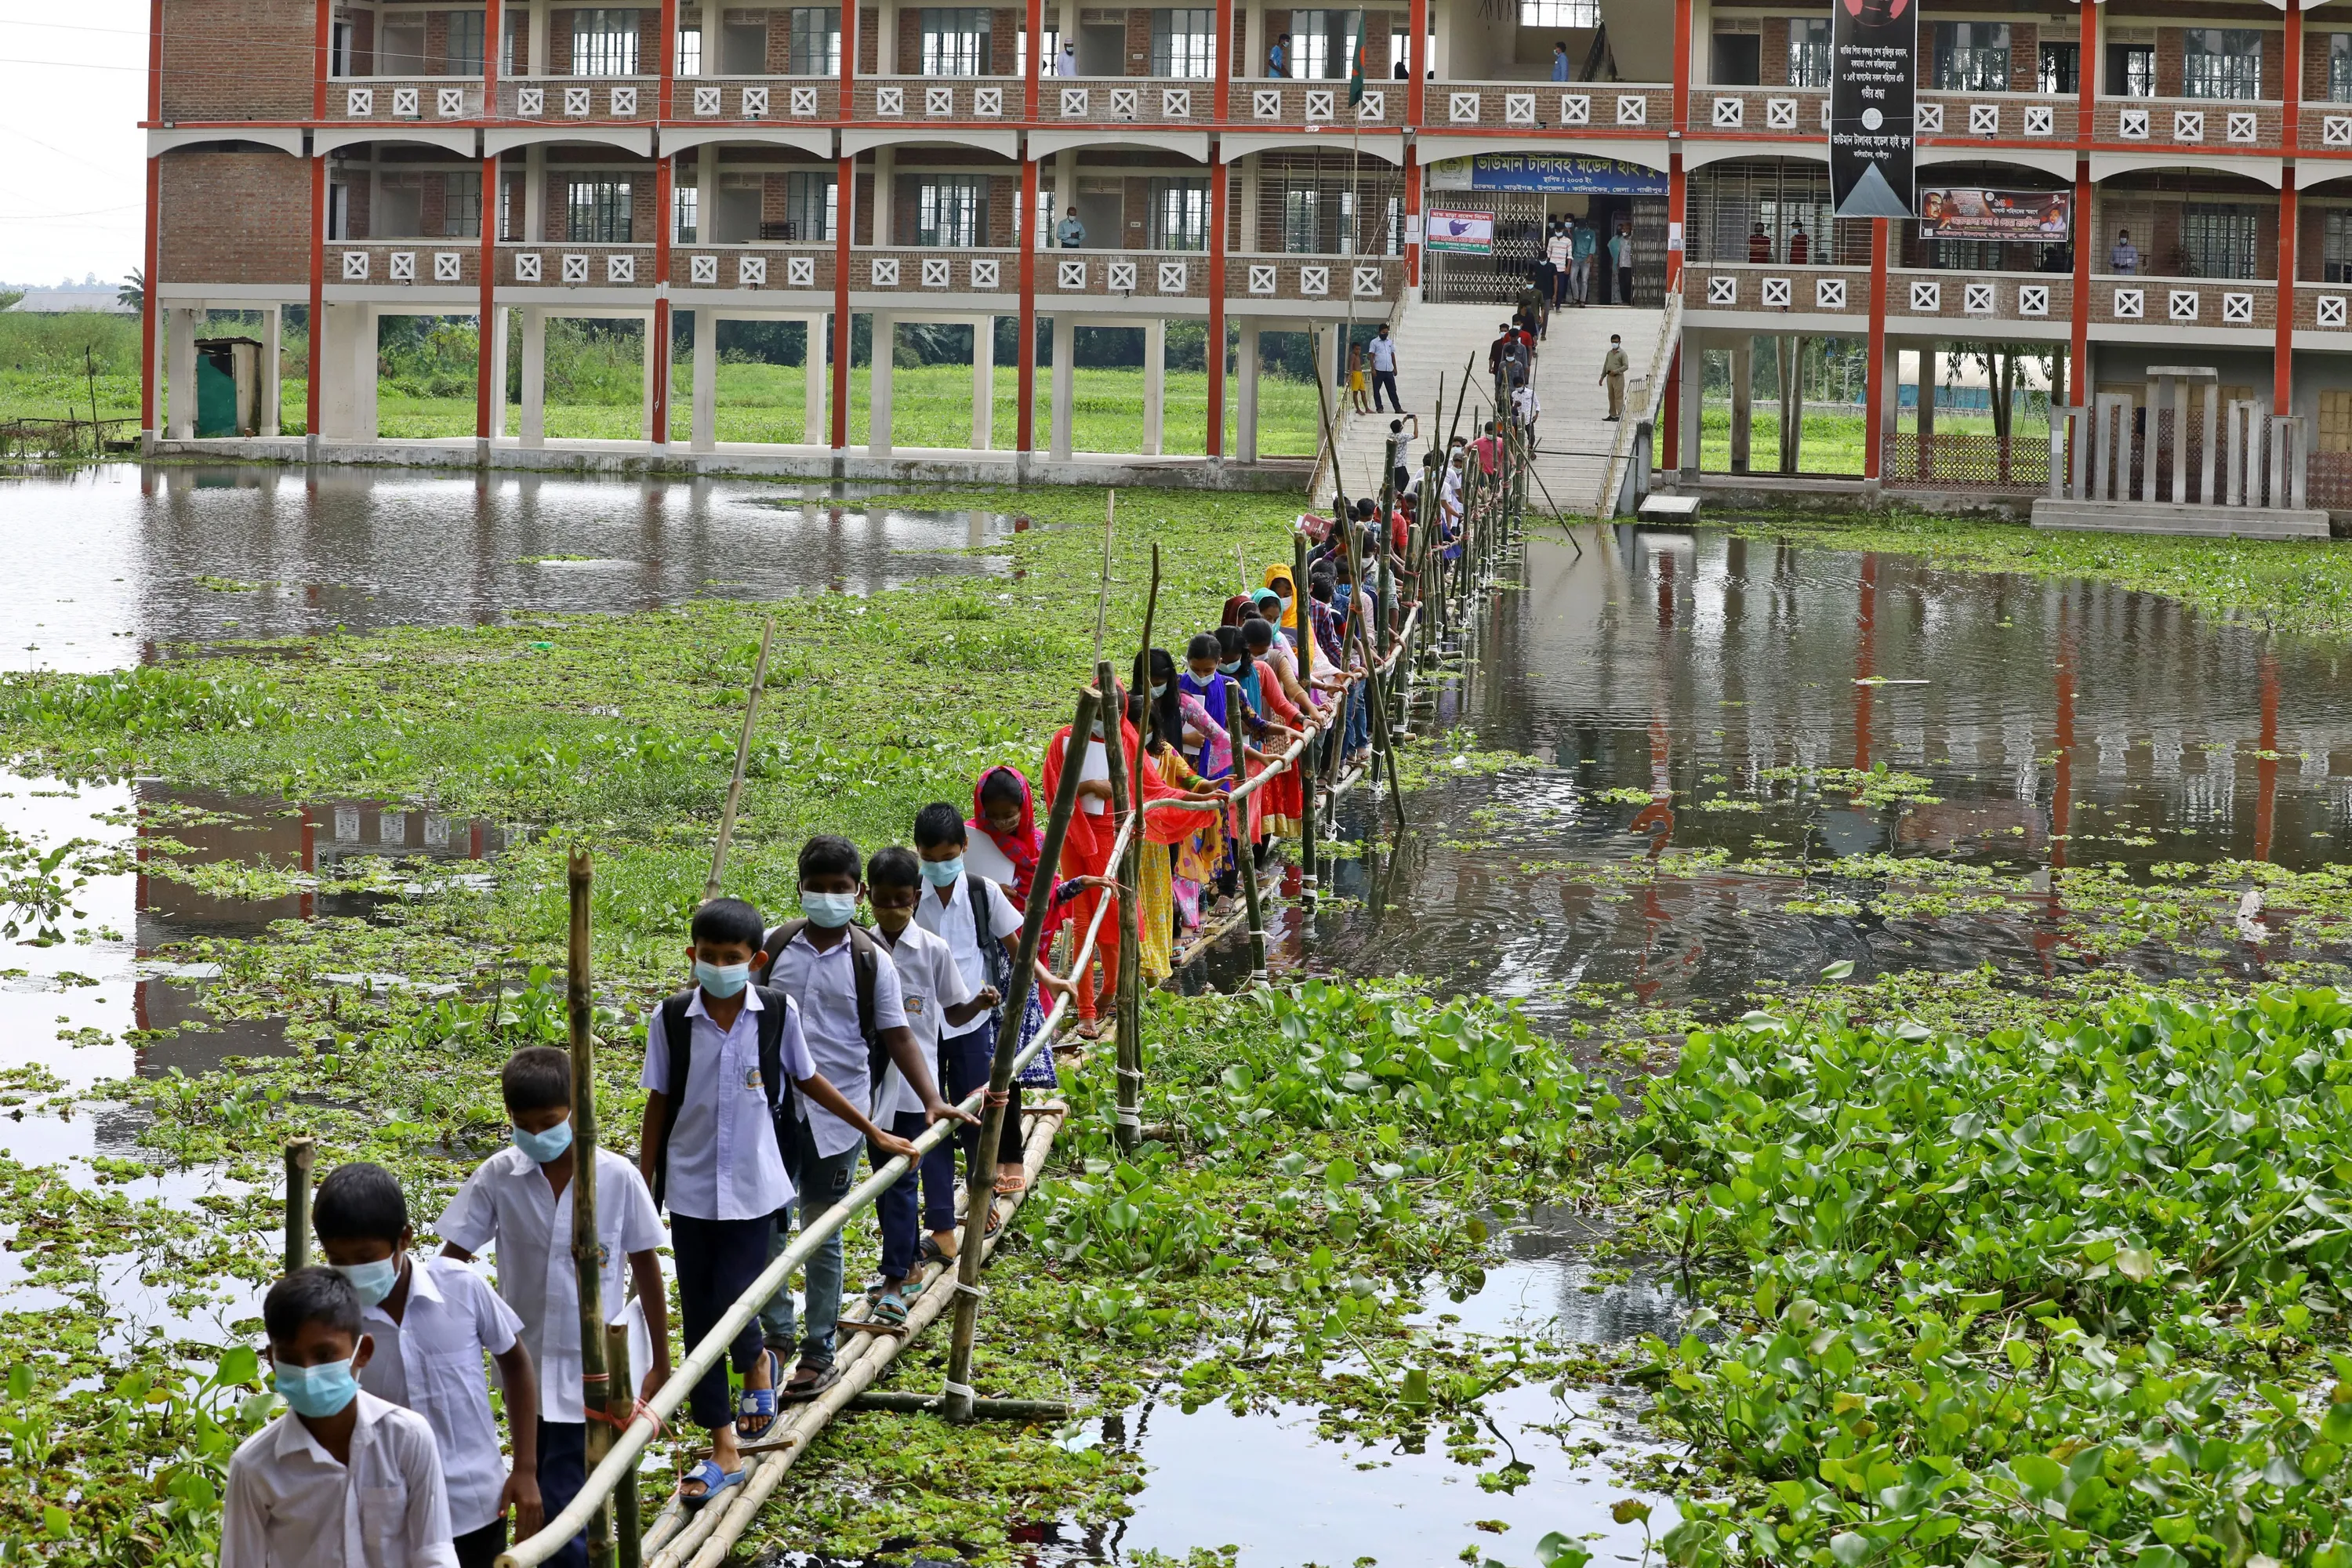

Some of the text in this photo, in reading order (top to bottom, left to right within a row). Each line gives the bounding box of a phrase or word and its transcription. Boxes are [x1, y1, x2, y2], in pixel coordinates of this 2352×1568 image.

[1840, 45, 1851, 55] জাতির
[1852, 45, 1860, 55] পিতা
[1873, 47, 1882, 56] শেখ
[1861, 85, 1885, 100] গভীর শ্রদ্ধা
[1833, 132, 1911, 151] ভাউমান টালাবহ মডেল হাই স্কুল
[1476, 154, 1523, 172] ভাউমান
[1526, 154, 1572, 176] টালাবহ
[1575, 158, 1612, 174] মডেল
[1542, 175, 1560, 183] স্থাপিত
[1584, 176, 1593, 184] ইং
[1994, 199, 2006, 208] ১৫
[1951, 216, 1980, 226] আলোচনা
[1993, 217, 1999, 227] ও
